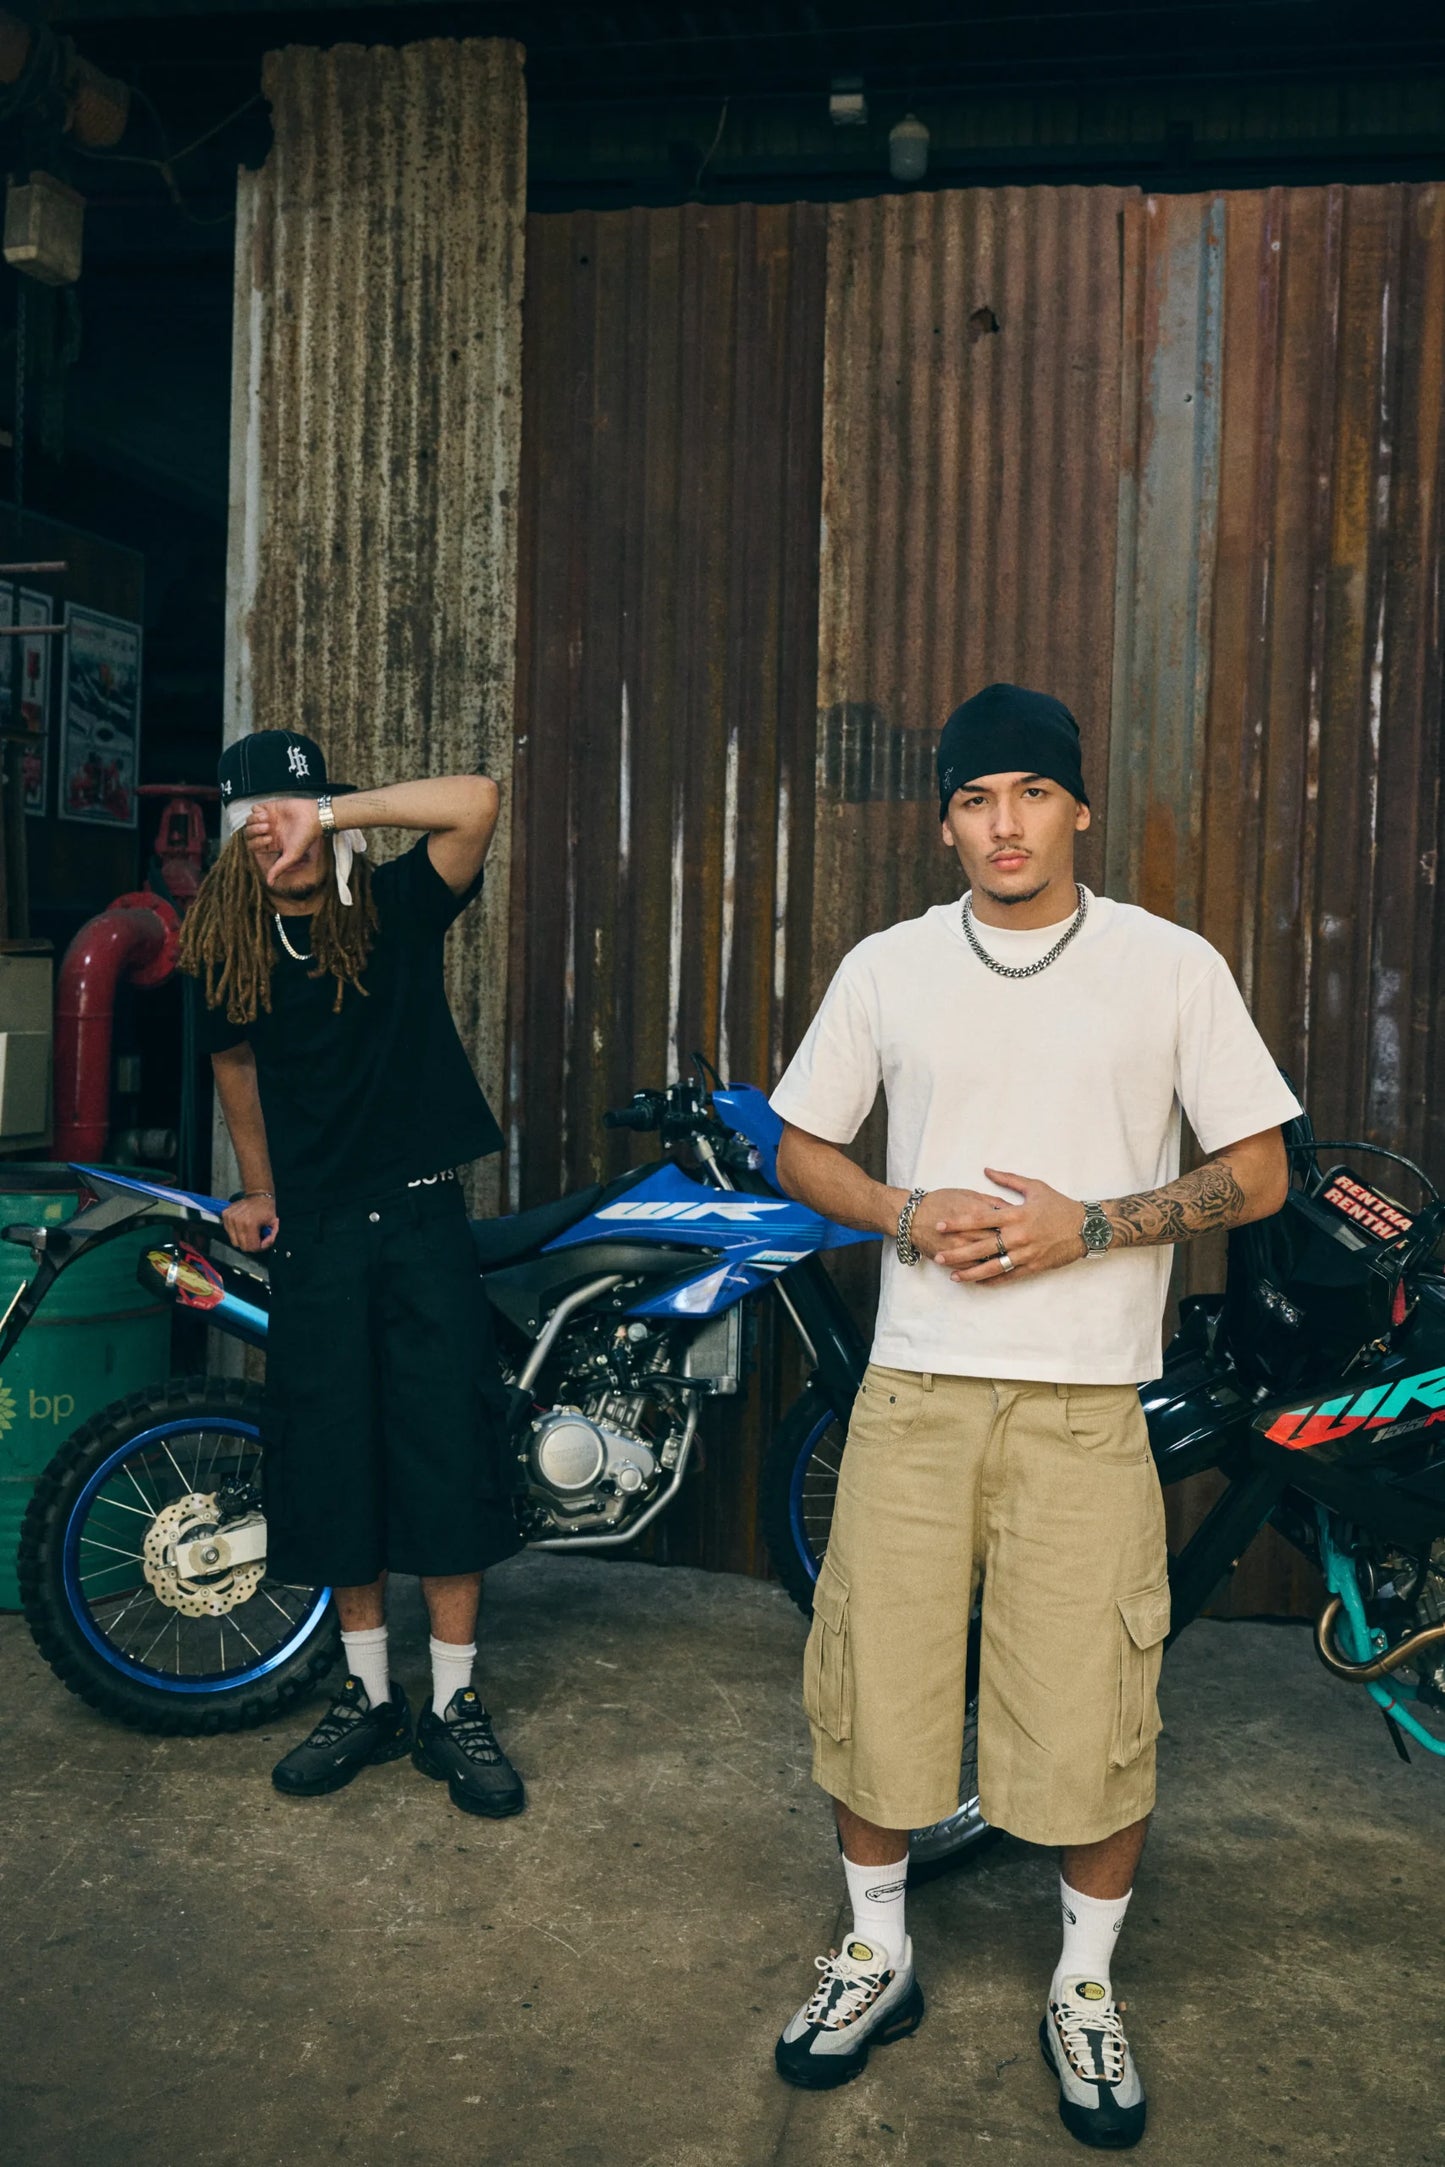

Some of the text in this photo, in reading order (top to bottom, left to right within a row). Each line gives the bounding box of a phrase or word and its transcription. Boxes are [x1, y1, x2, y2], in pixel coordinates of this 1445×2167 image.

[594, 1202, 790, 1221] WR
[1333, 1175, 1413, 1231] RENTHA
[29, 1389, 75, 1425] bp
[1263, 1366, 1445, 1451] WR
